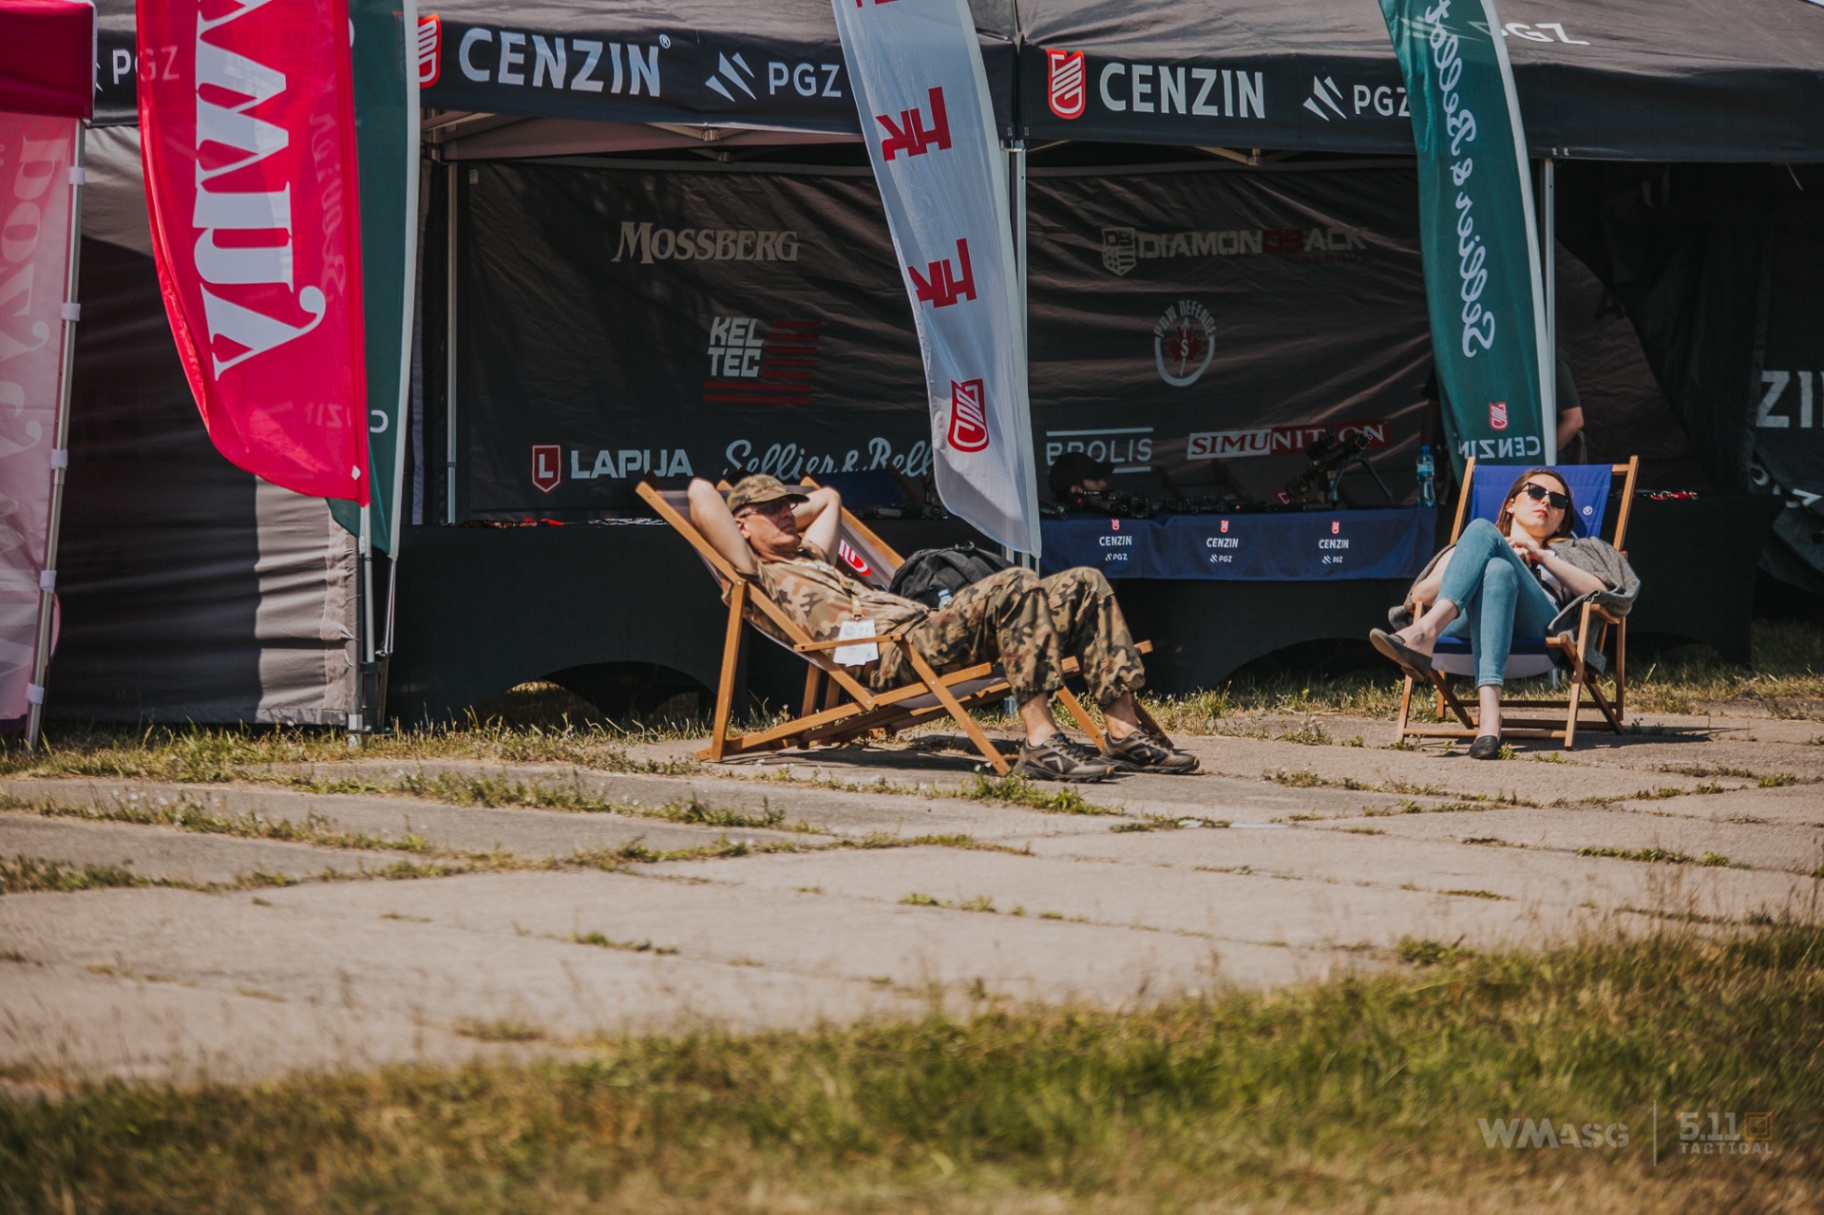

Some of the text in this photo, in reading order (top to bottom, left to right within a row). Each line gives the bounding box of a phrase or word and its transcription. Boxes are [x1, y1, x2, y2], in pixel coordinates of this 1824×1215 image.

[768, 61, 842, 98] PGZ
[1099, 62, 1266, 119] CENZIN
[1353, 85, 1412, 116] PGZ
[611, 221, 800, 264] MOSSBERG
[709, 316, 764, 347] KEL
[707, 347, 762, 377] TEC
[1189, 422, 1386, 456] SIMUNITON
[571, 449, 693, 479] LAPUA
[1099, 535, 1133, 546] CENZIN
[1206, 537, 1239, 548] CENZIN
[1318, 539, 1349, 549] CENZIN
[1113, 553, 1128, 561] PGZ
[1219, 555, 1233, 563] PGZ
